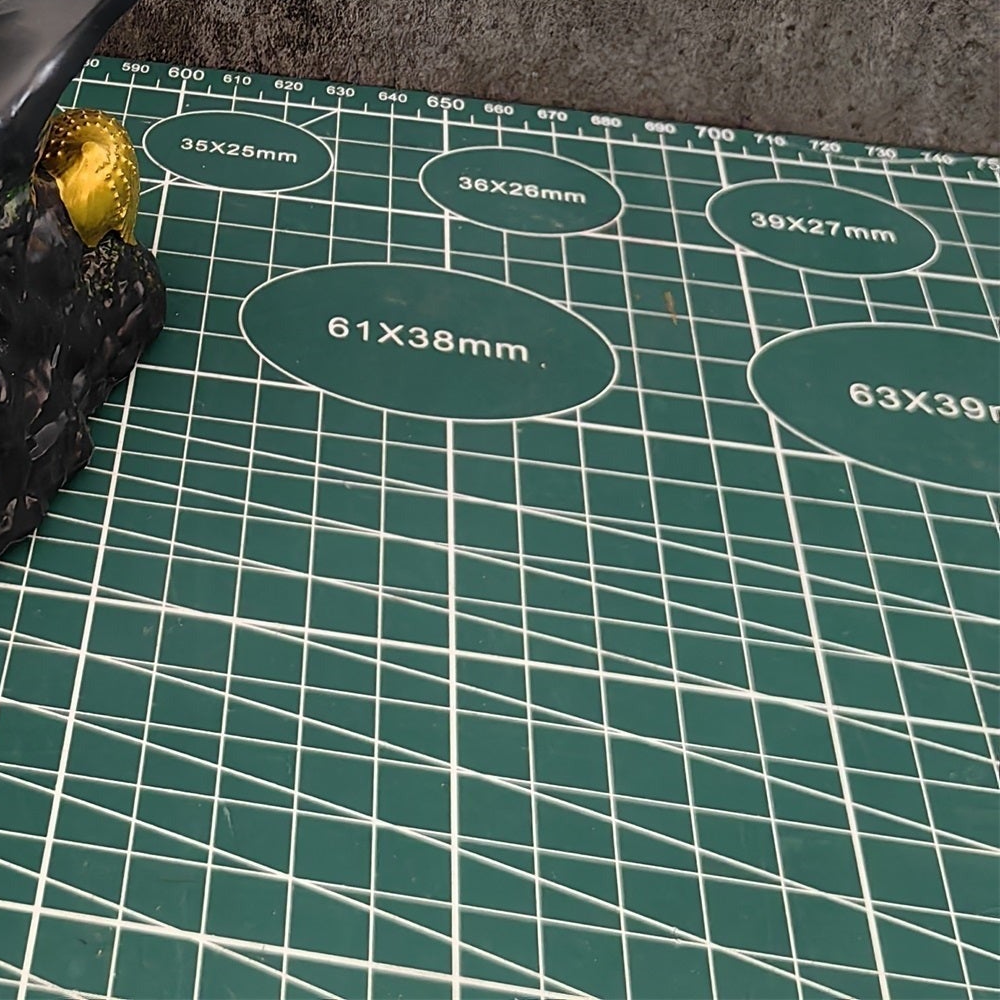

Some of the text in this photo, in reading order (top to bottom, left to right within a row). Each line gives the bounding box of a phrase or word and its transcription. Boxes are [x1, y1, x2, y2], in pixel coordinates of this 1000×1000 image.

[121, 62, 150, 74] 590
[168, 66, 205, 81] 600
[223, 74, 252, 86] 610
[274, 79, 303, 92] 620
[326, 85, 355, 98] 630
[378, 91, 408, 104] 640
[426, 96, 465, 112] 650
[484, 103, 515, 116] 660
[536, 109, 569, 123] 670
[590, 114, 623, 129] 680
[644, 120, 677, 135] 690
[694, 125, 736, 143] 700
[180, 138, 298, 164] 35X25mm
[808, 139, 842, 154] 720
[864, 145, 898, 160] 730
[458, 175, 587, 205] 36X26mm
[750, 211, 898, 244] 39X27mm
[327, 315, 529, 363] 61X38mm
